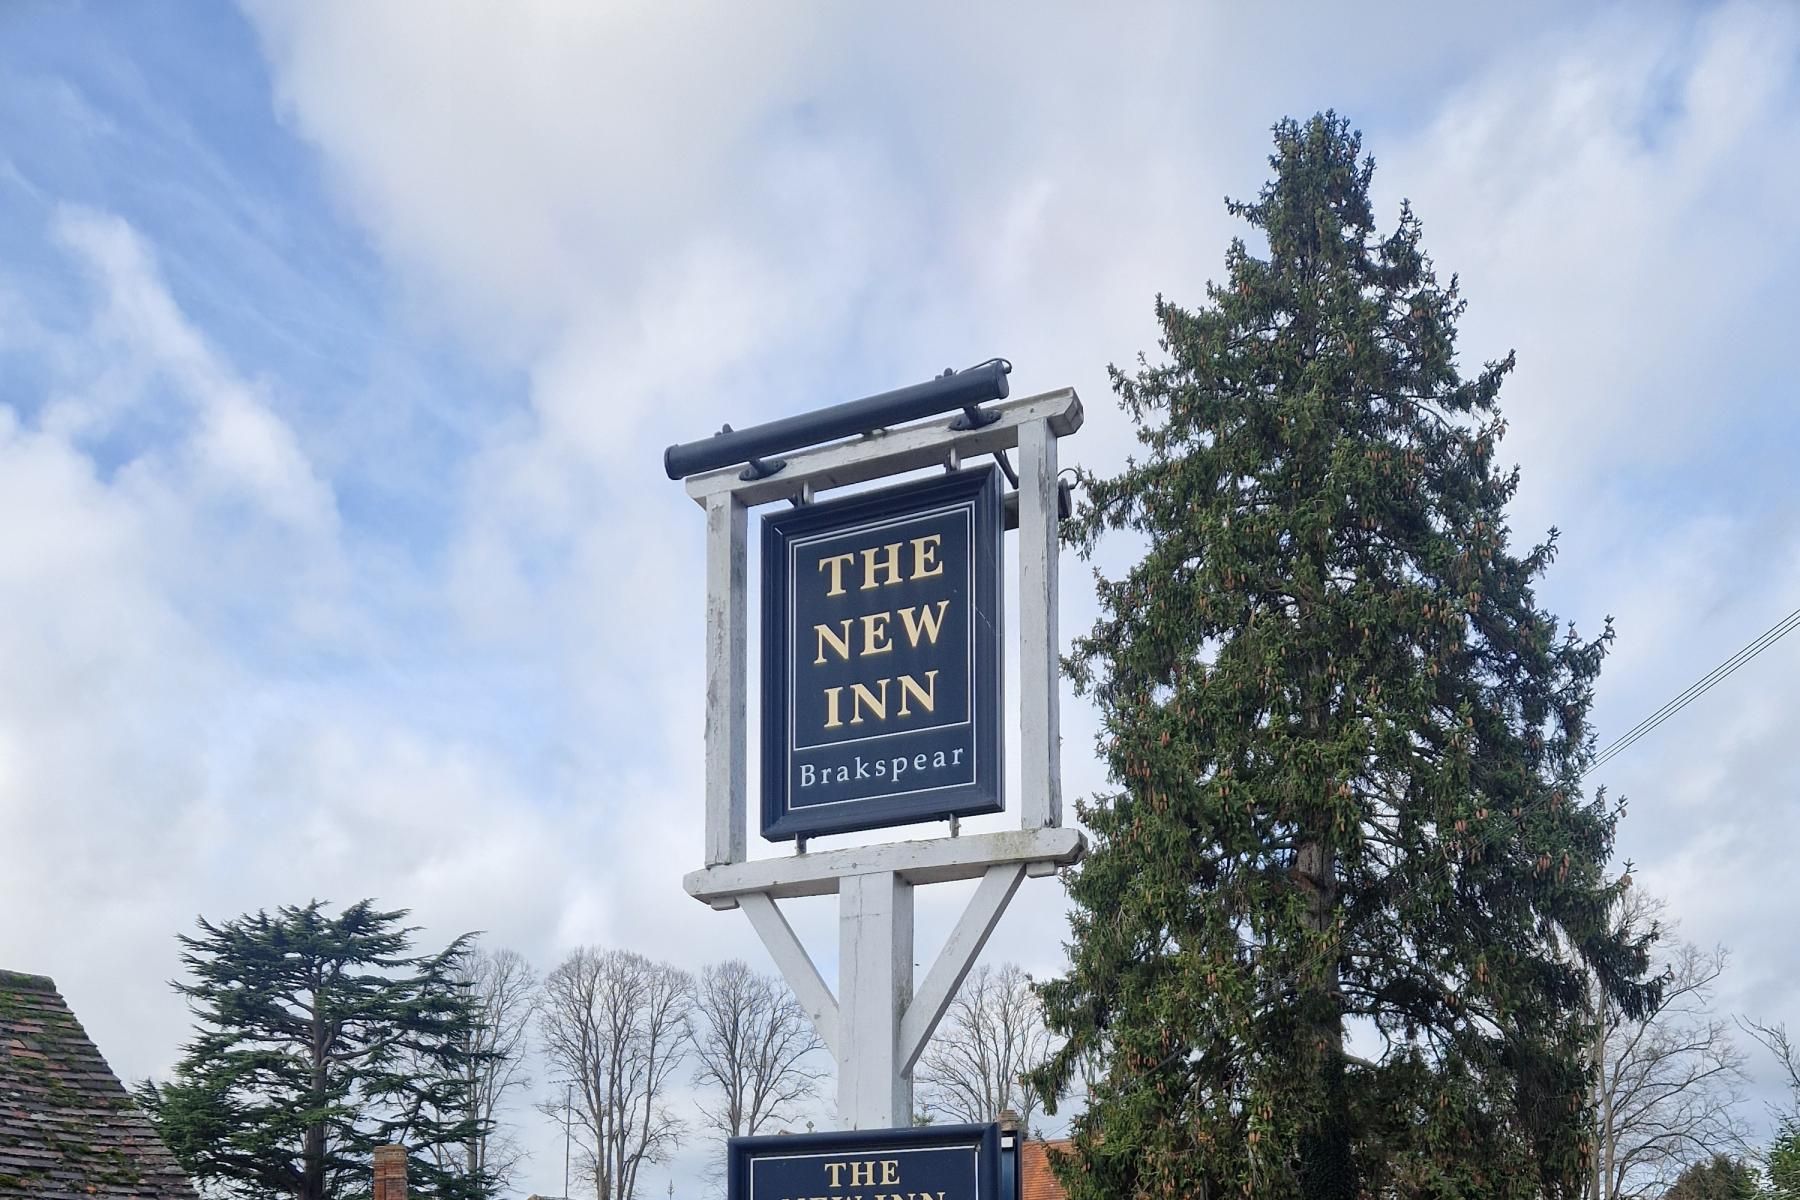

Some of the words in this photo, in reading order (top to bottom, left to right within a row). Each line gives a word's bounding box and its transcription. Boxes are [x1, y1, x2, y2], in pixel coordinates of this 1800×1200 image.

[818, 533, 944, 597] THE
[813, 600, 950, 665] NEW
[824, 670, 939, 728] INN
[800, 745, 964, 787] Brakspear
[824, 1160, 900, 1187] THE
